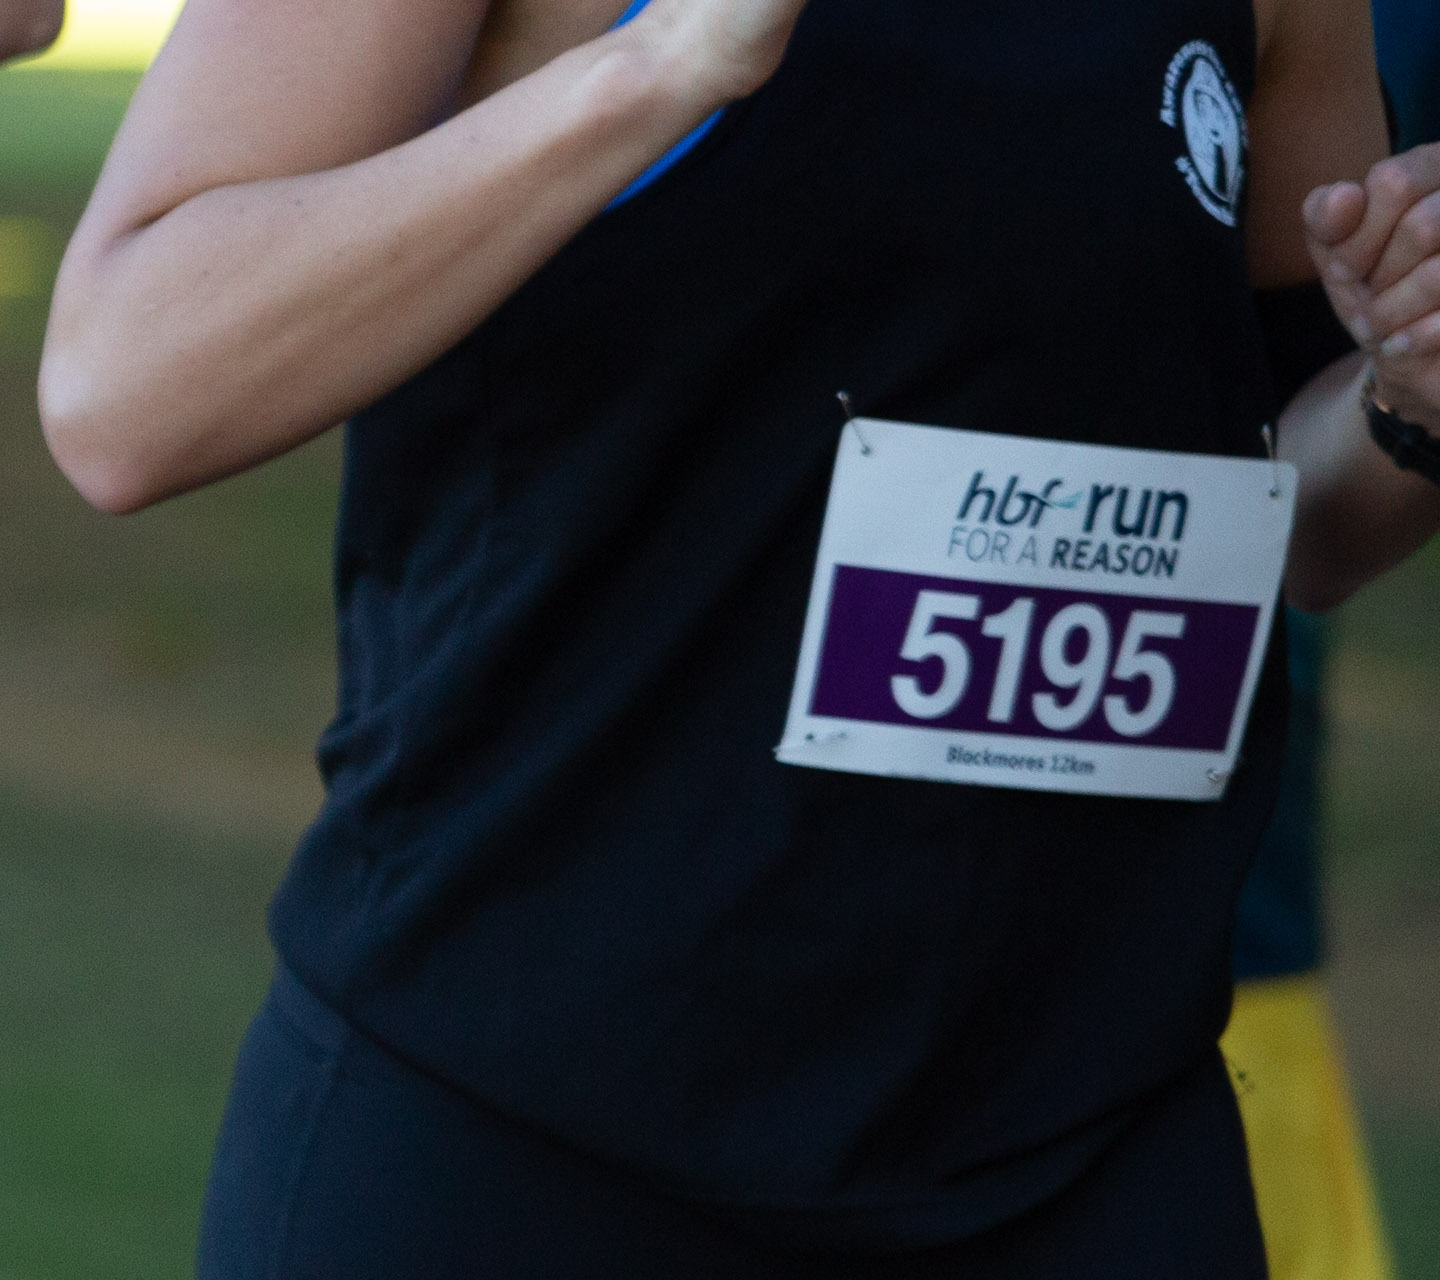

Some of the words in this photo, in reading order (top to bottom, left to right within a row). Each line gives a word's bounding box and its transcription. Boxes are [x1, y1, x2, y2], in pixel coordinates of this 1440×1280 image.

[957, 470, 1064, 529] hbf
[1081, 481, 1189, 541] run
[947, 525, 1012, 566] FOR
[1016, 532, 1039, 568] A
[1049, 538, 1180, 578] REASON
[890, 589, 1186, 738] 5195
[946, 744, 1046, 772] Blackmores
[1050, 752, 1097, 775] 12km
